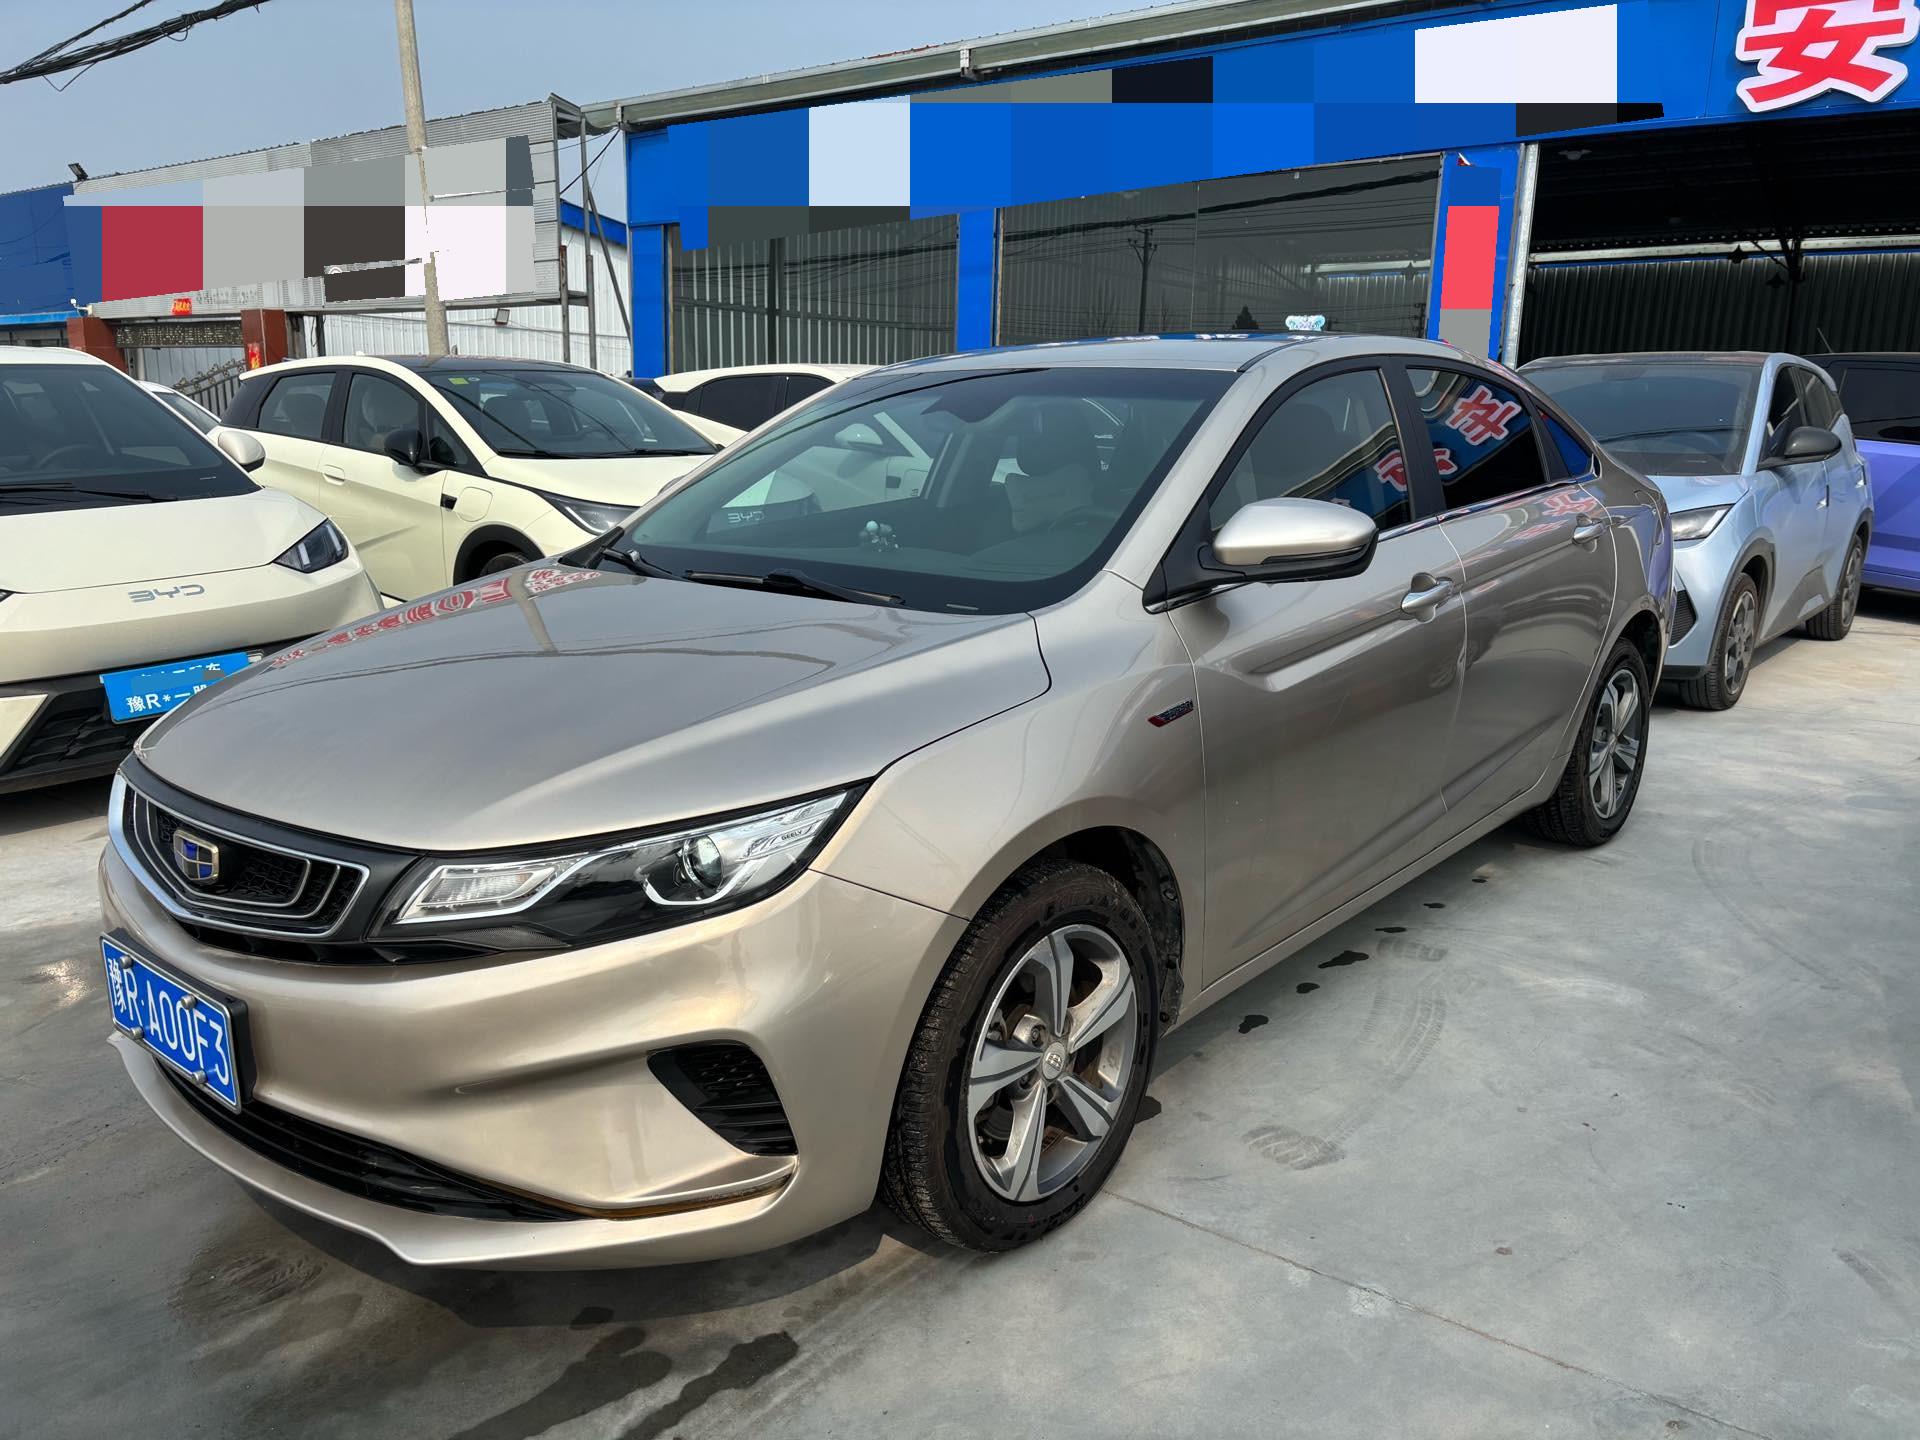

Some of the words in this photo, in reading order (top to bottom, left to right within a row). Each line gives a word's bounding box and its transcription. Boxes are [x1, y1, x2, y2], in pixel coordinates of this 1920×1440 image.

[1737, 0, 1918, 111] 安
[727, 510, 765, 523] BYD
[128, 584, 205, 603] BYD
